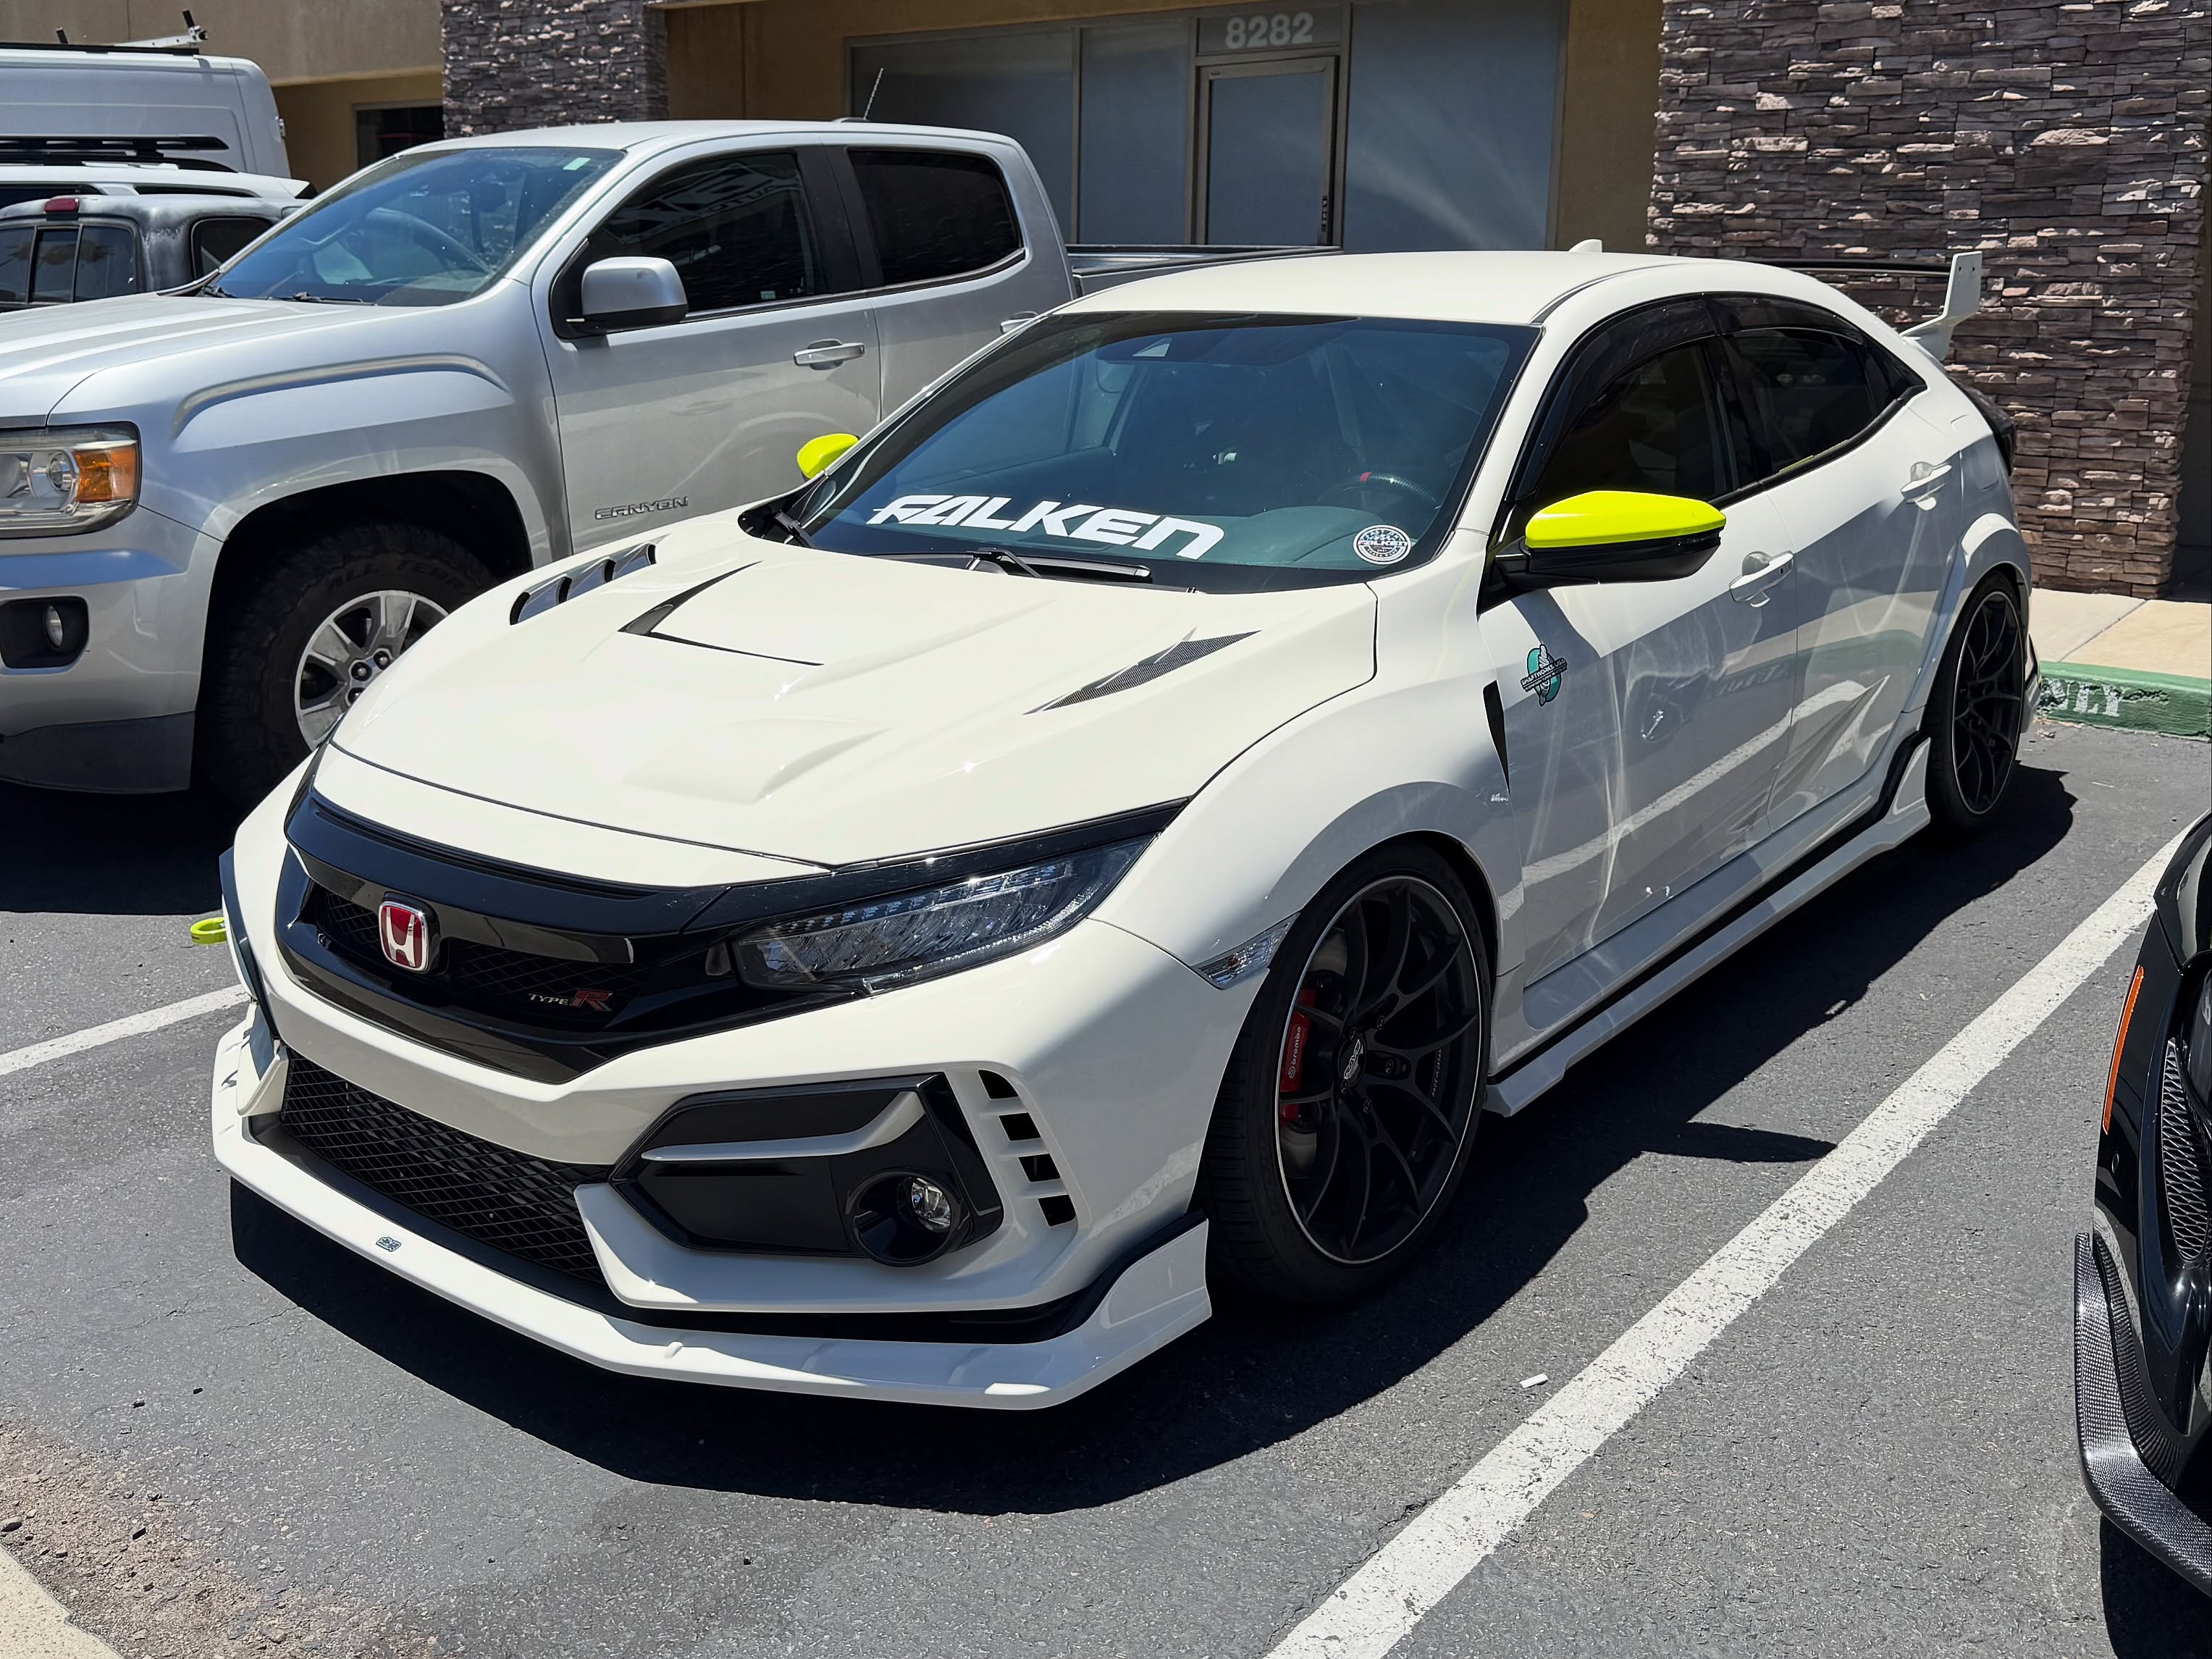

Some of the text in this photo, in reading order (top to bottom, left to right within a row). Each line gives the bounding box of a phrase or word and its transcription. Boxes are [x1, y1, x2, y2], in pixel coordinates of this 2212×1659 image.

[1225, 12, 1314, 49] 8282
[595, 496, 689, 520] CANYON
[866, 495, 1224, 560] FALKEN
[529, 989, 613, 1012] TYPE R
[1291, 1026, 1302, 1065] brembo
